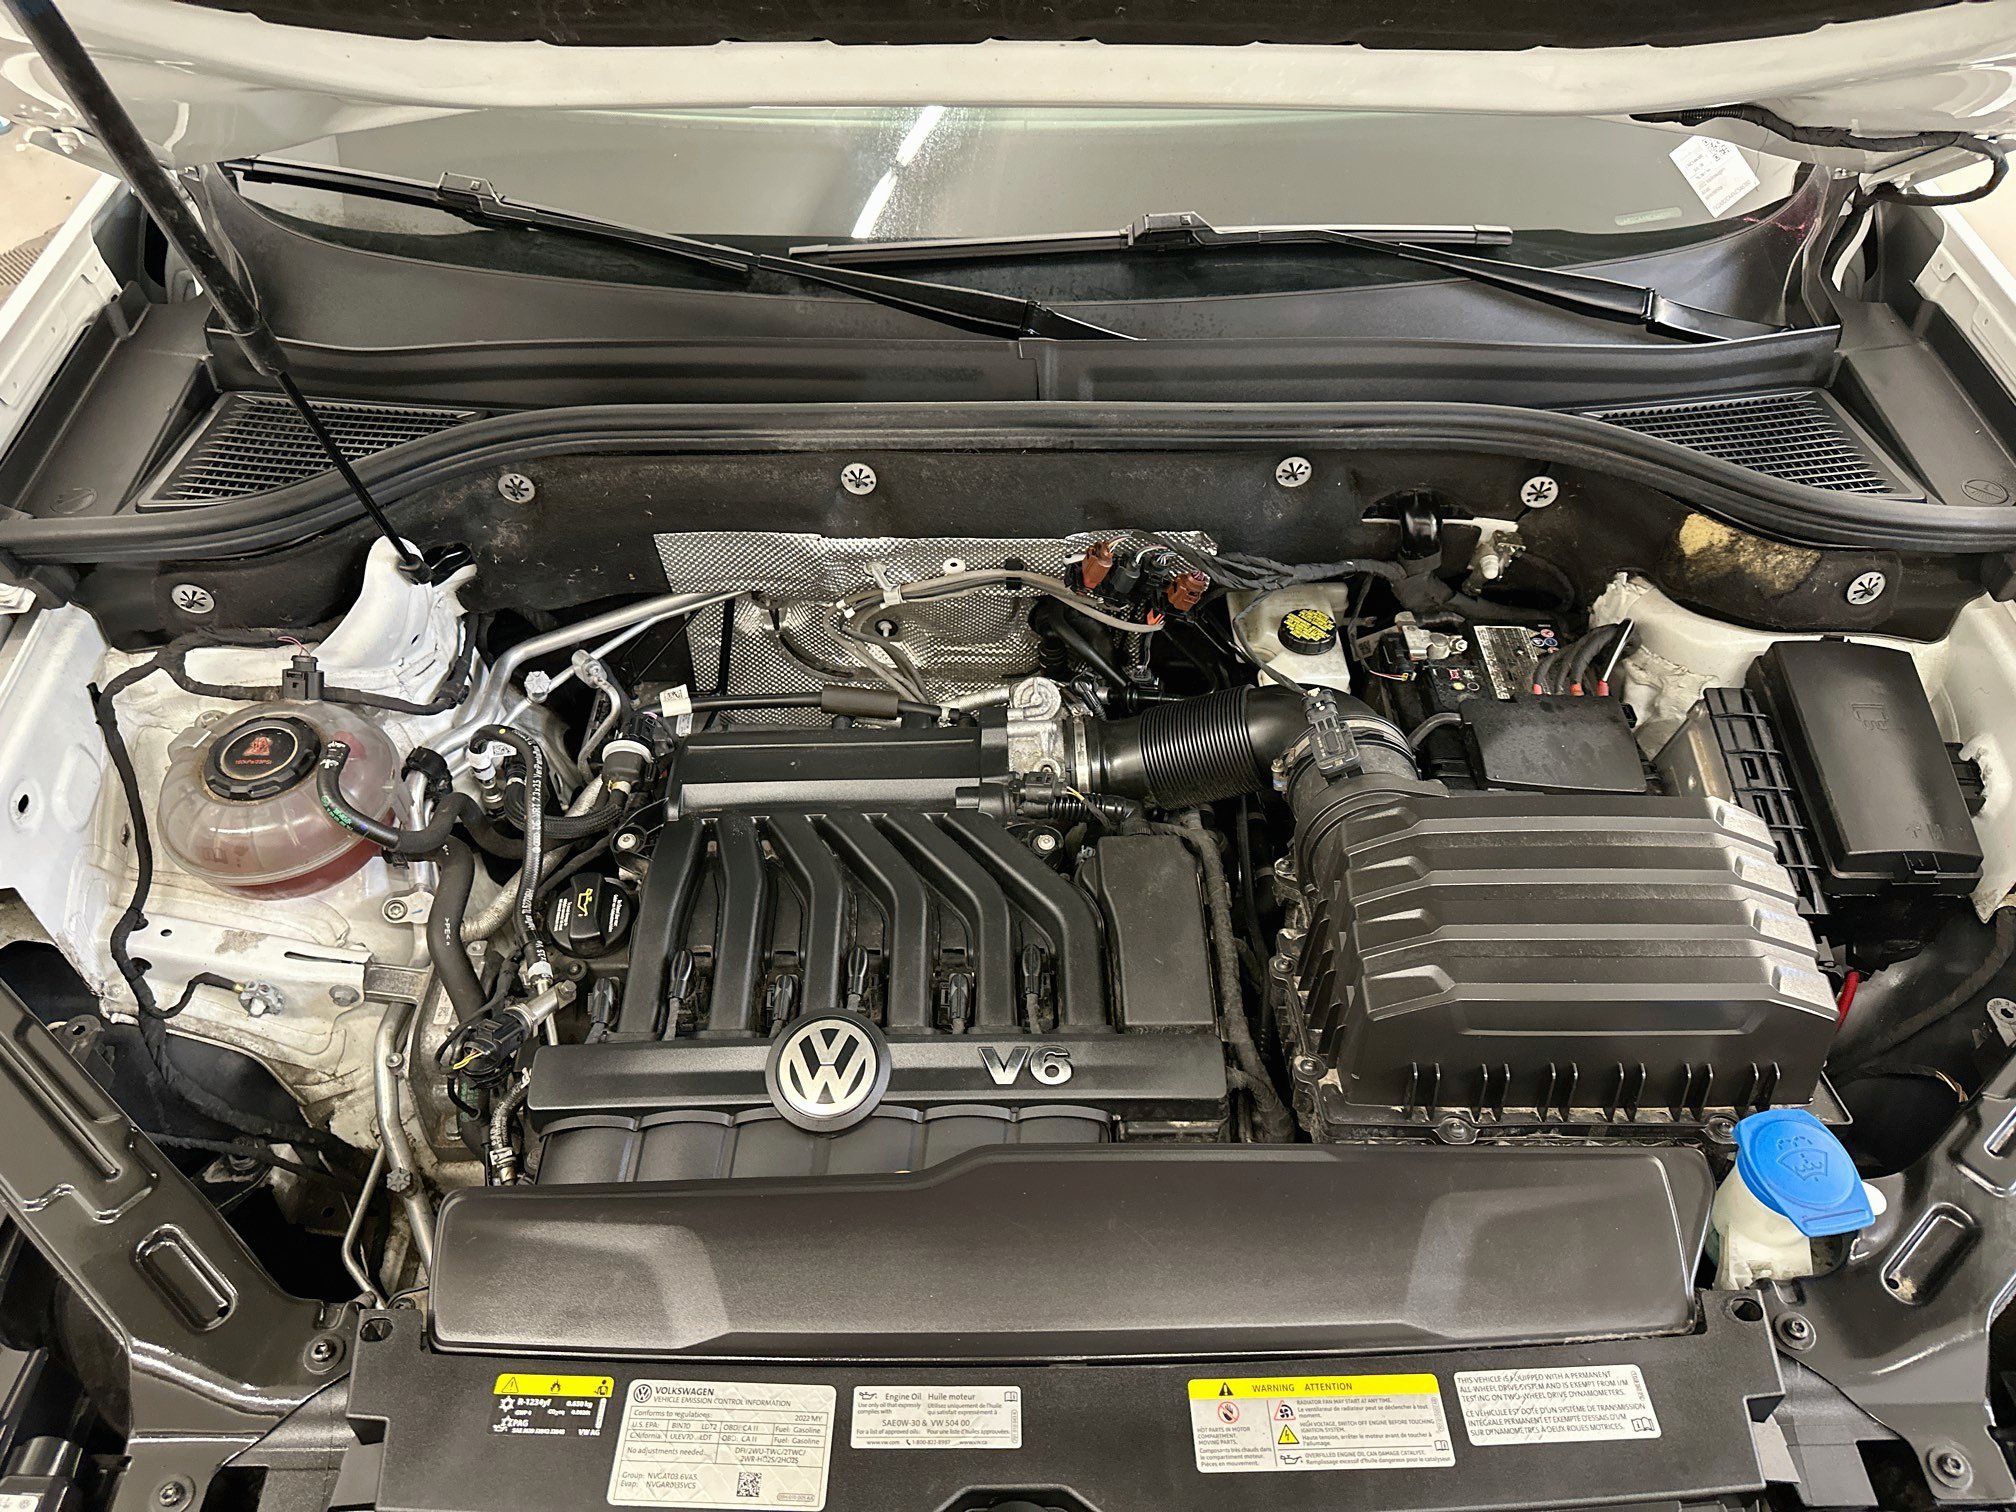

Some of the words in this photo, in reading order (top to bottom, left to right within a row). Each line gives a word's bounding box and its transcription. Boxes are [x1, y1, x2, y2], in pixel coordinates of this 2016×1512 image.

[978, 1044, 1073, 1085] V6
[1571, 1371, 1610, 1379] PERMANENT
[656, 1386, 714, 1396] VOLKSWAGEN
[1252, 1384, 1294, 1393] WARNING
[1304, 1382, 1352, 1391] ATTENTION
[1498, 1384, 1520, 1392] DRIVE
[885, 1393, 909, 1402] Engine
[517, 1398, 552, 1408] R-1234yf
[745, 1399, 791, 1407] INFORMATION
[1597, 1403, 1645, 1411] TRANSMISSION
[634, 1409, 665, 1417] Conforms
[675, 1410, 712, 1419] regulations:
[513, 1419, 528, 1427] PAG
[1567, 1424, 1589, 1432] ROUES
[1590, 1423, 1624, 1431] MOTRICES.
[792, 1437, 820, 1445] Gasoline
[638, 1448, 678, 1457] adjustments
[679, 1448, 704, 1456] needed.
[622, 1472, 644, 1480] Group:
